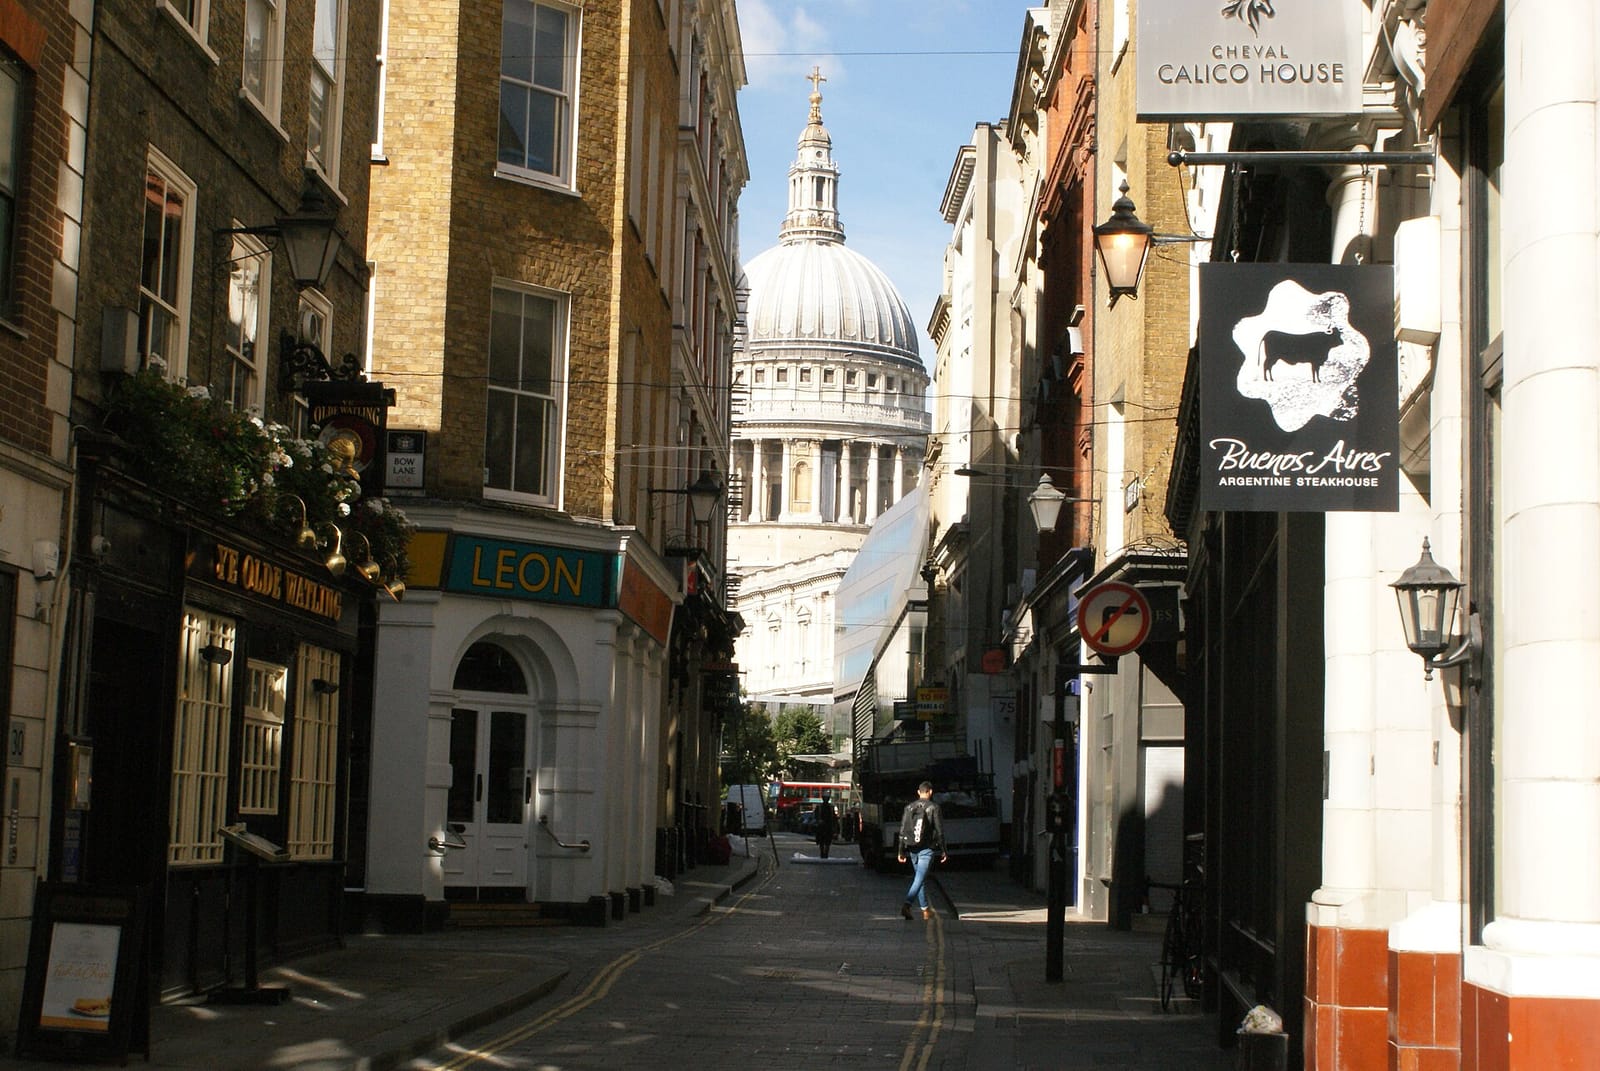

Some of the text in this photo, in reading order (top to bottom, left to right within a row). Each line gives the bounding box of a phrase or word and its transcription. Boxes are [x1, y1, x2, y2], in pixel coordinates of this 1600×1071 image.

[1211, 45, 1289, 59] CHEVAL
[1158, 63, 1344, 84] CALICO HOUSE
[313, 406, 381, 426] OLDE WATLING
[394, 457, 416, 466] BOW
[1209, 438, 1391, 476] Buenos Aires
[393, 467, 416, 475] LANE
[1218, 477, 1379, 487] ARGENTINE STEAKHOUSE
[472, 546, 583, 597] LEON
[215, 543, 342, 622] YE OLDE WATLING
